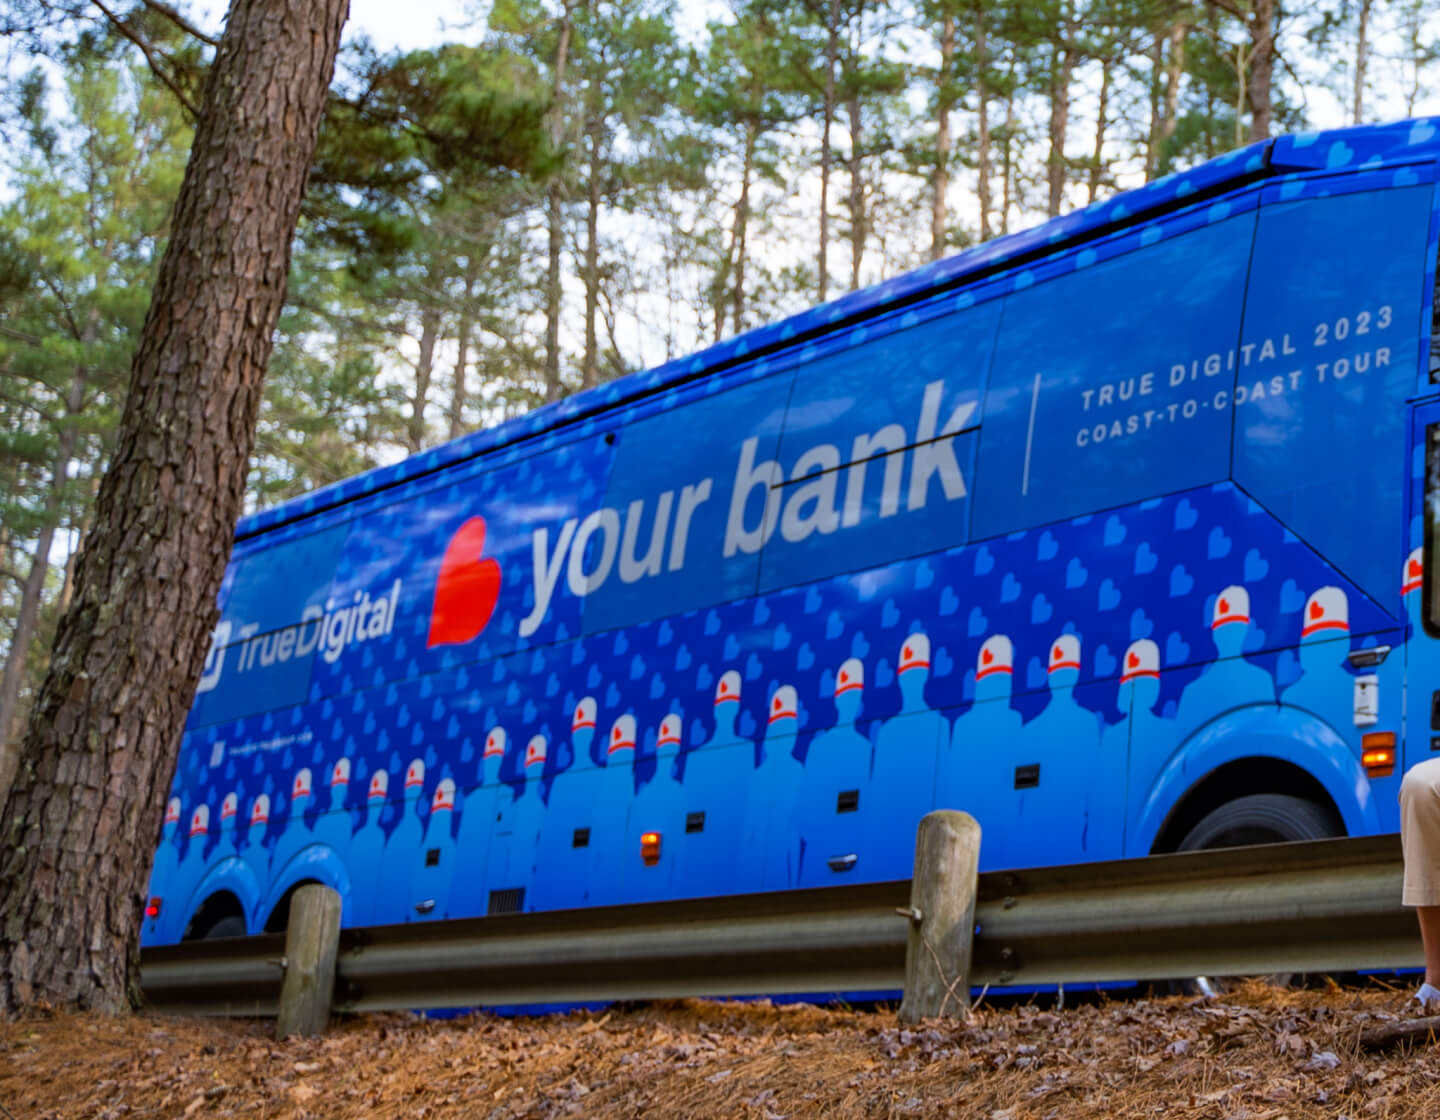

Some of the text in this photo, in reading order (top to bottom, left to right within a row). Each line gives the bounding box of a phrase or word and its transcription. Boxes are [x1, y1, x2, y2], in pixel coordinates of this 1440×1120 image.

[1081, 305, 1393, 412] TRUE DIGITAL 2023
[1316, 347, 1392, 384] TOUR
[518, 379, 978, 638] your bank
[237, 578, 402, 665] TrueDigital
